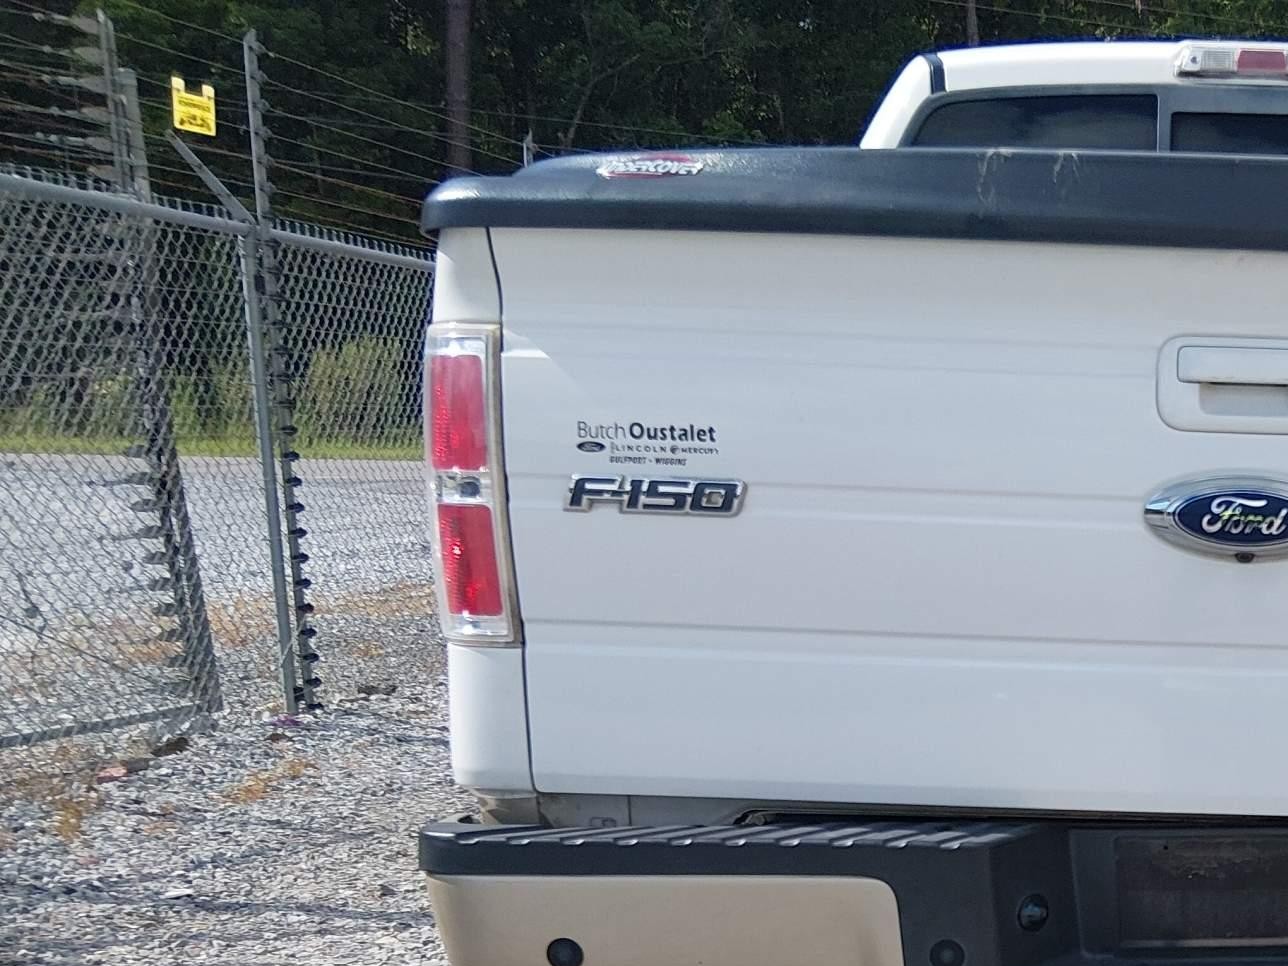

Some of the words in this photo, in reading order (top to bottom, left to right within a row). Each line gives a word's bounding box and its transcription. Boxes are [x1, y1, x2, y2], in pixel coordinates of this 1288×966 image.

[577, 421, 626, 439] Butch
[629, 422, 716, 442] Oustalet
[615, 444, 667, 453] LINCOLN
[564, 473, 747, 517] F-150
[1202, 496, 1288, 535] Ford
